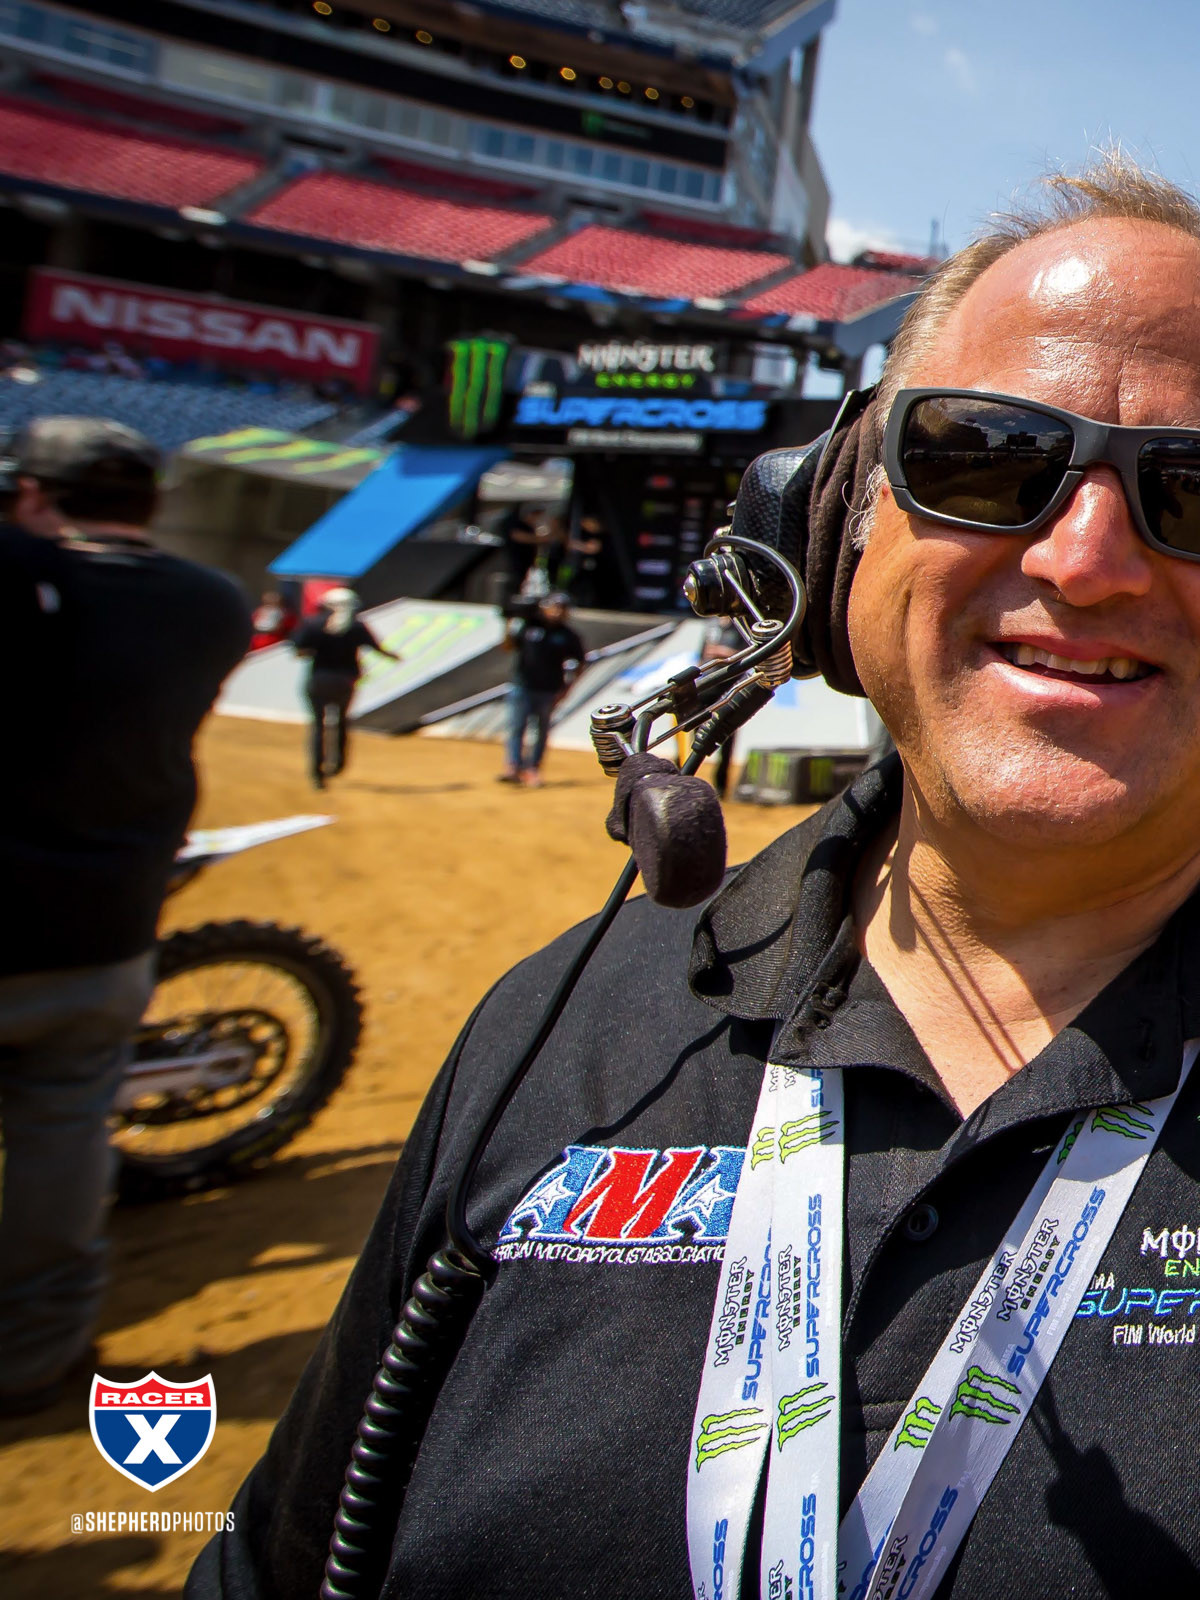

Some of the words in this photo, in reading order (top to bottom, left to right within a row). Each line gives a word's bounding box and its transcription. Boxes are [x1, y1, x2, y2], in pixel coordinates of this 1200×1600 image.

[50, 284, 360, 368] NISSAN
[577, 341, 715, 372] MONSTER
[498, 1146, 748, 1244] AMA
[714, 1256, 748, 1368] MONSTER
[735, 1269, 755, 1346] ENERGY
[775, 1244, 793, 1352] MONSTER
[806, 1193, 822, 1378] SUPERCROSS
[950, 1251, 1018, 1353] MONSTER
[997, 1217, 1059, 1321] MONSTER
[1007, 1185, 1107, 1377] SUPERCROSS
[1020, 1235, 1060, 1310] ENERGY
[1112, 1324, 1142, 1345] FIM
[1148, 1322, 1196, 1344] World
